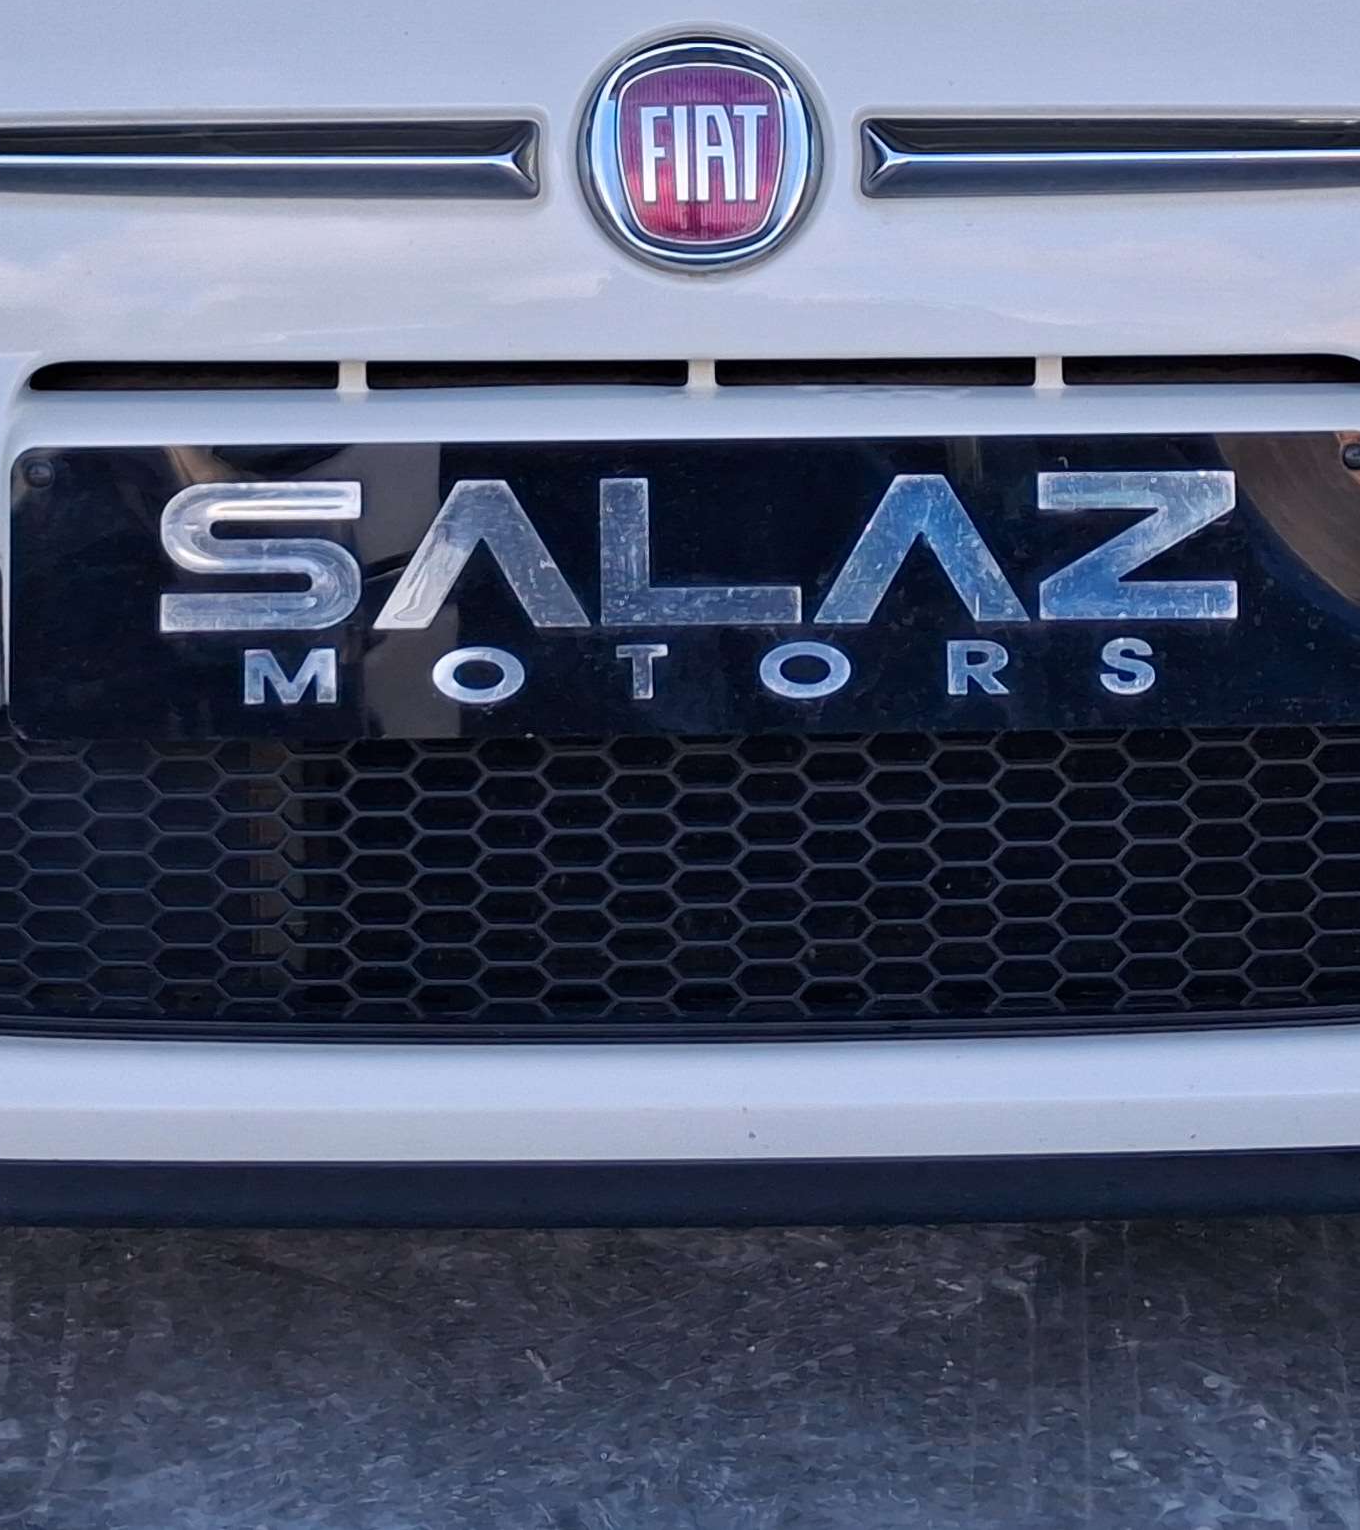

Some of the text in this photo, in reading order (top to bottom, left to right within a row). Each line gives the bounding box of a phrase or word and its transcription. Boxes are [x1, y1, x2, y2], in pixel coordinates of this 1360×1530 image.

[641, 105, 769, 202] FIAT
[158, 469, 1238, 633] SALAZ
[242, 637, 1158, 706] MOTORS
